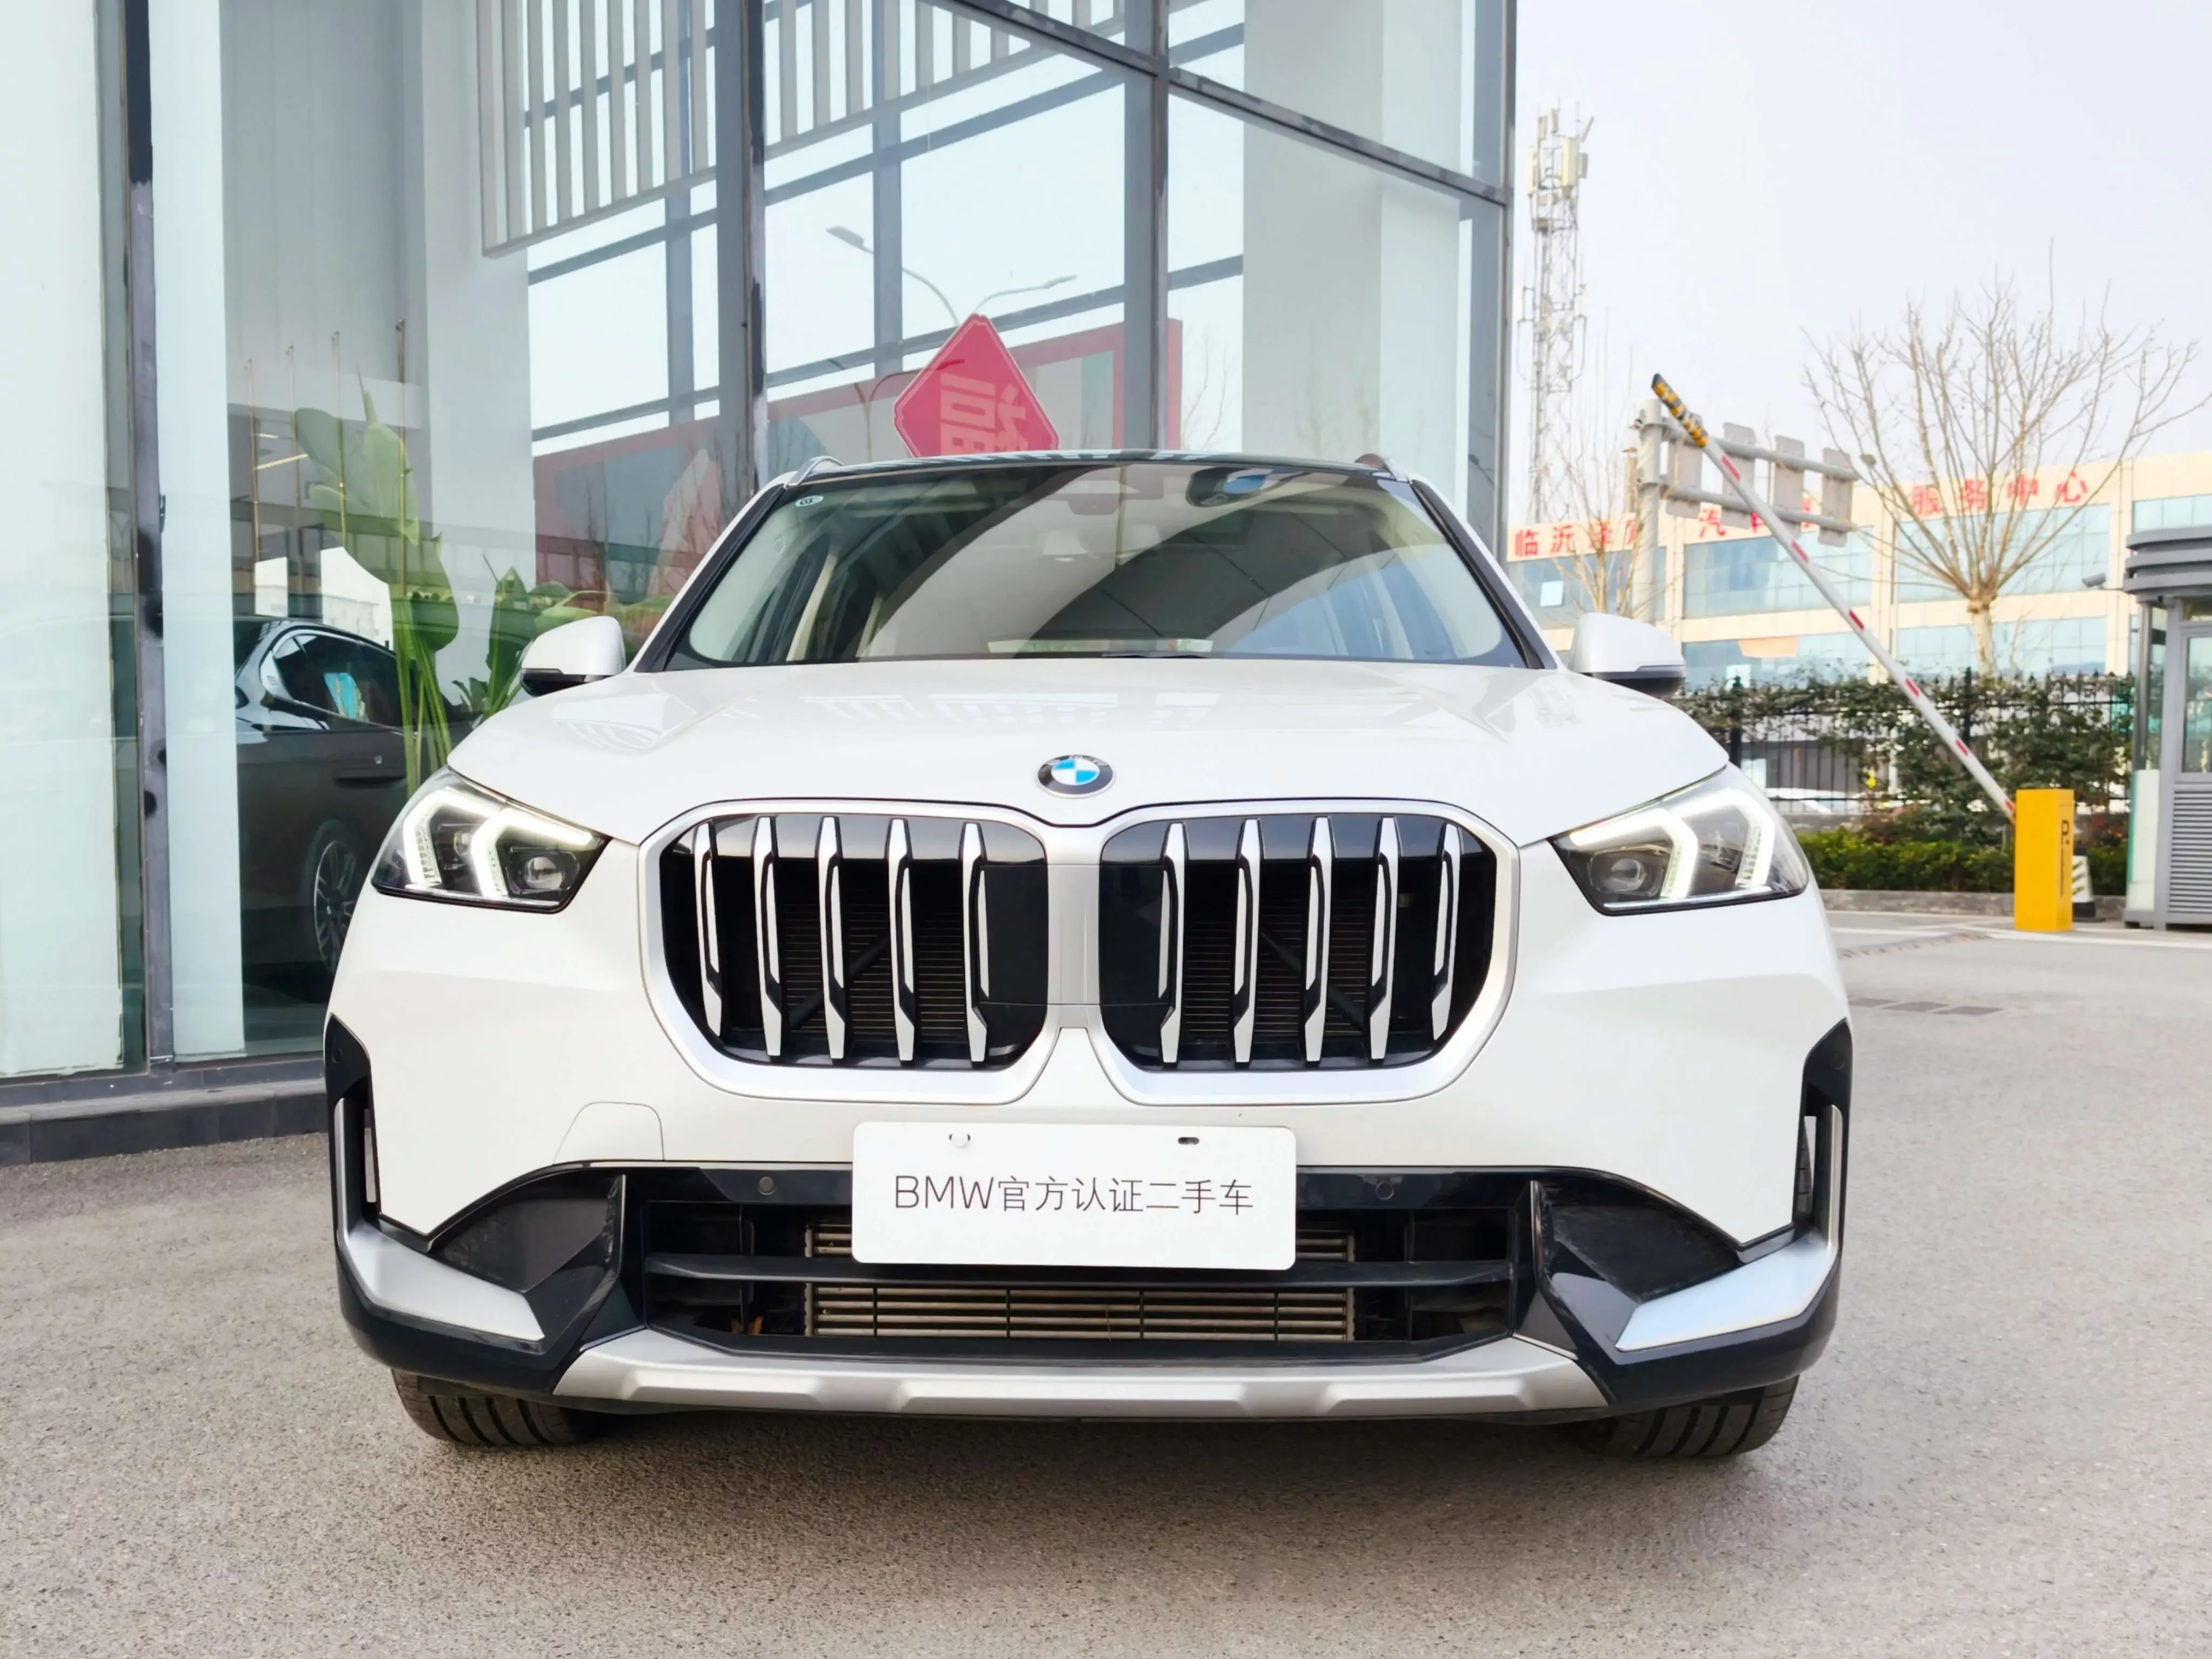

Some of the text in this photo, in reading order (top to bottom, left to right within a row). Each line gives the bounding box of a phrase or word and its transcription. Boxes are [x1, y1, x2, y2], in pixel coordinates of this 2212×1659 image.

[894, 1175, 1254, 1216] BMW官方认证二手车
